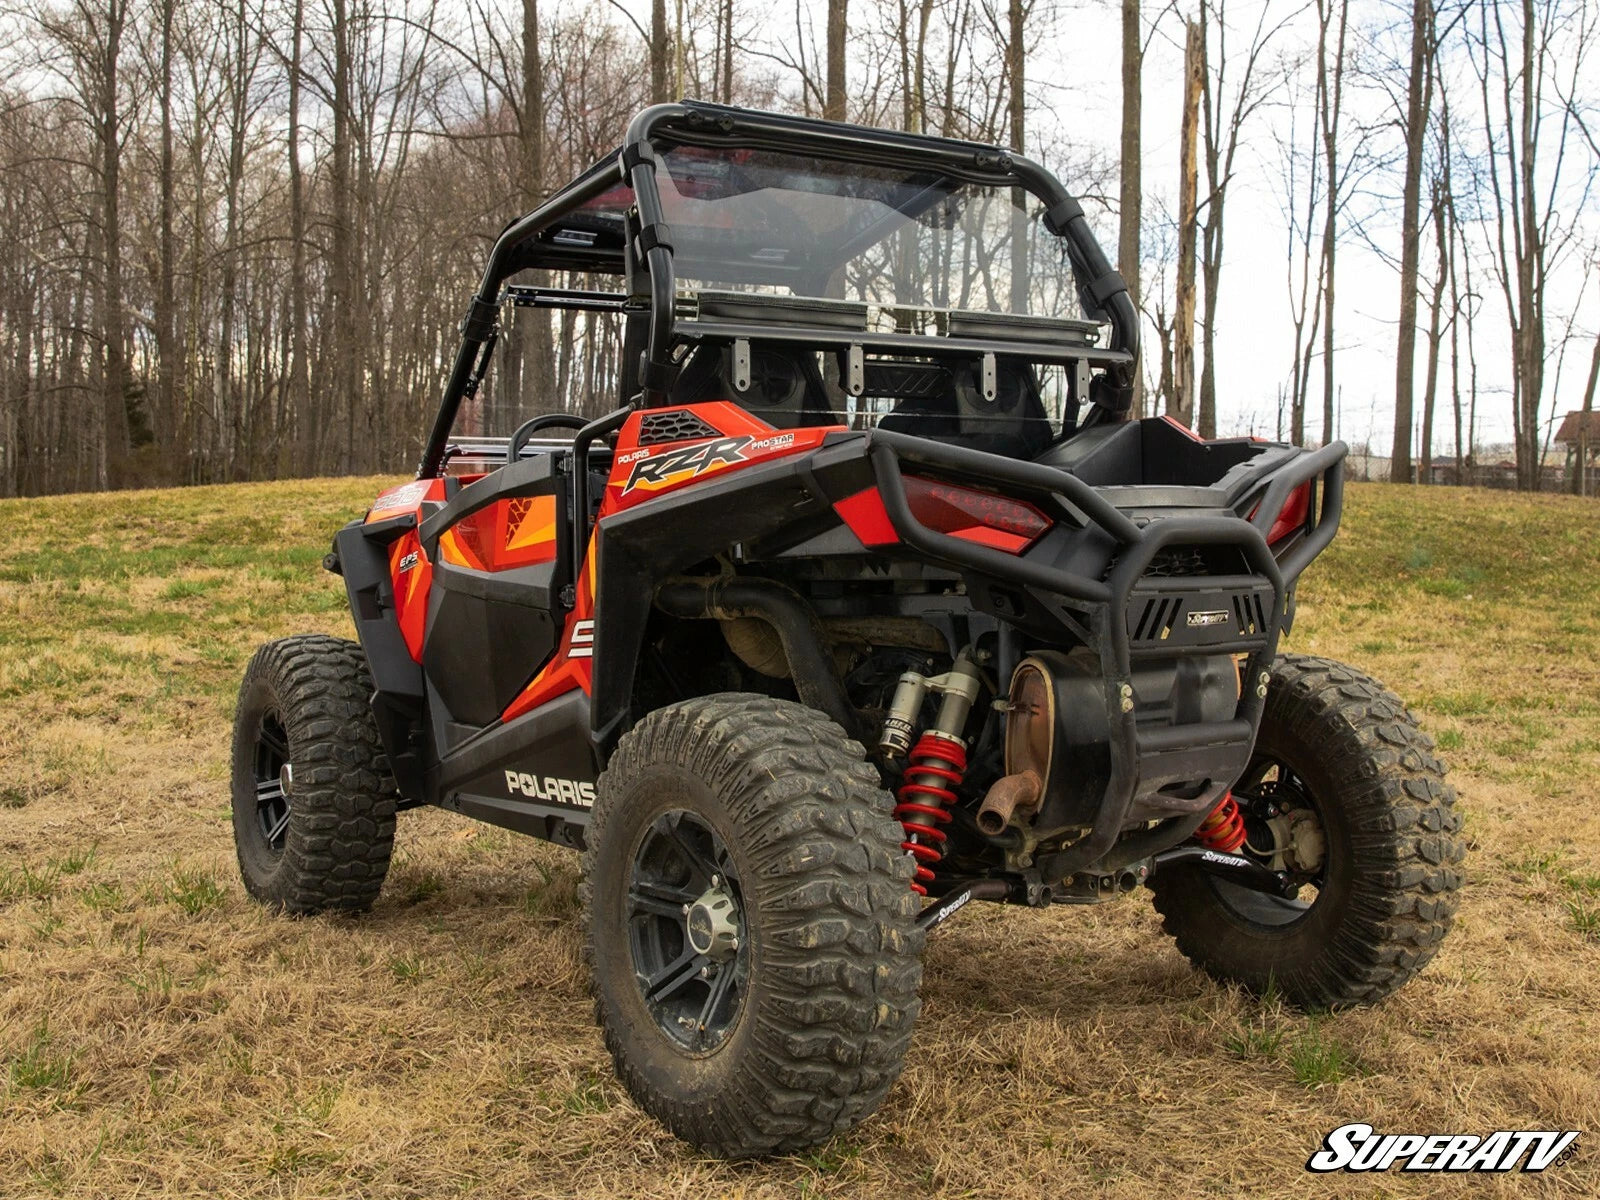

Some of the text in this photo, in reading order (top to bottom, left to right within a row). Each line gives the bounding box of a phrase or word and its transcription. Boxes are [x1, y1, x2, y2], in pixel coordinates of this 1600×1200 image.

[751, 433, 795, 450] PROSTAR
[617, 448, 650, 465] POLARIS
[621, 435, 755, 497] RZR
[399, 550, 419, 568] EPS
[504, 769, 597, 807] POLARIS
